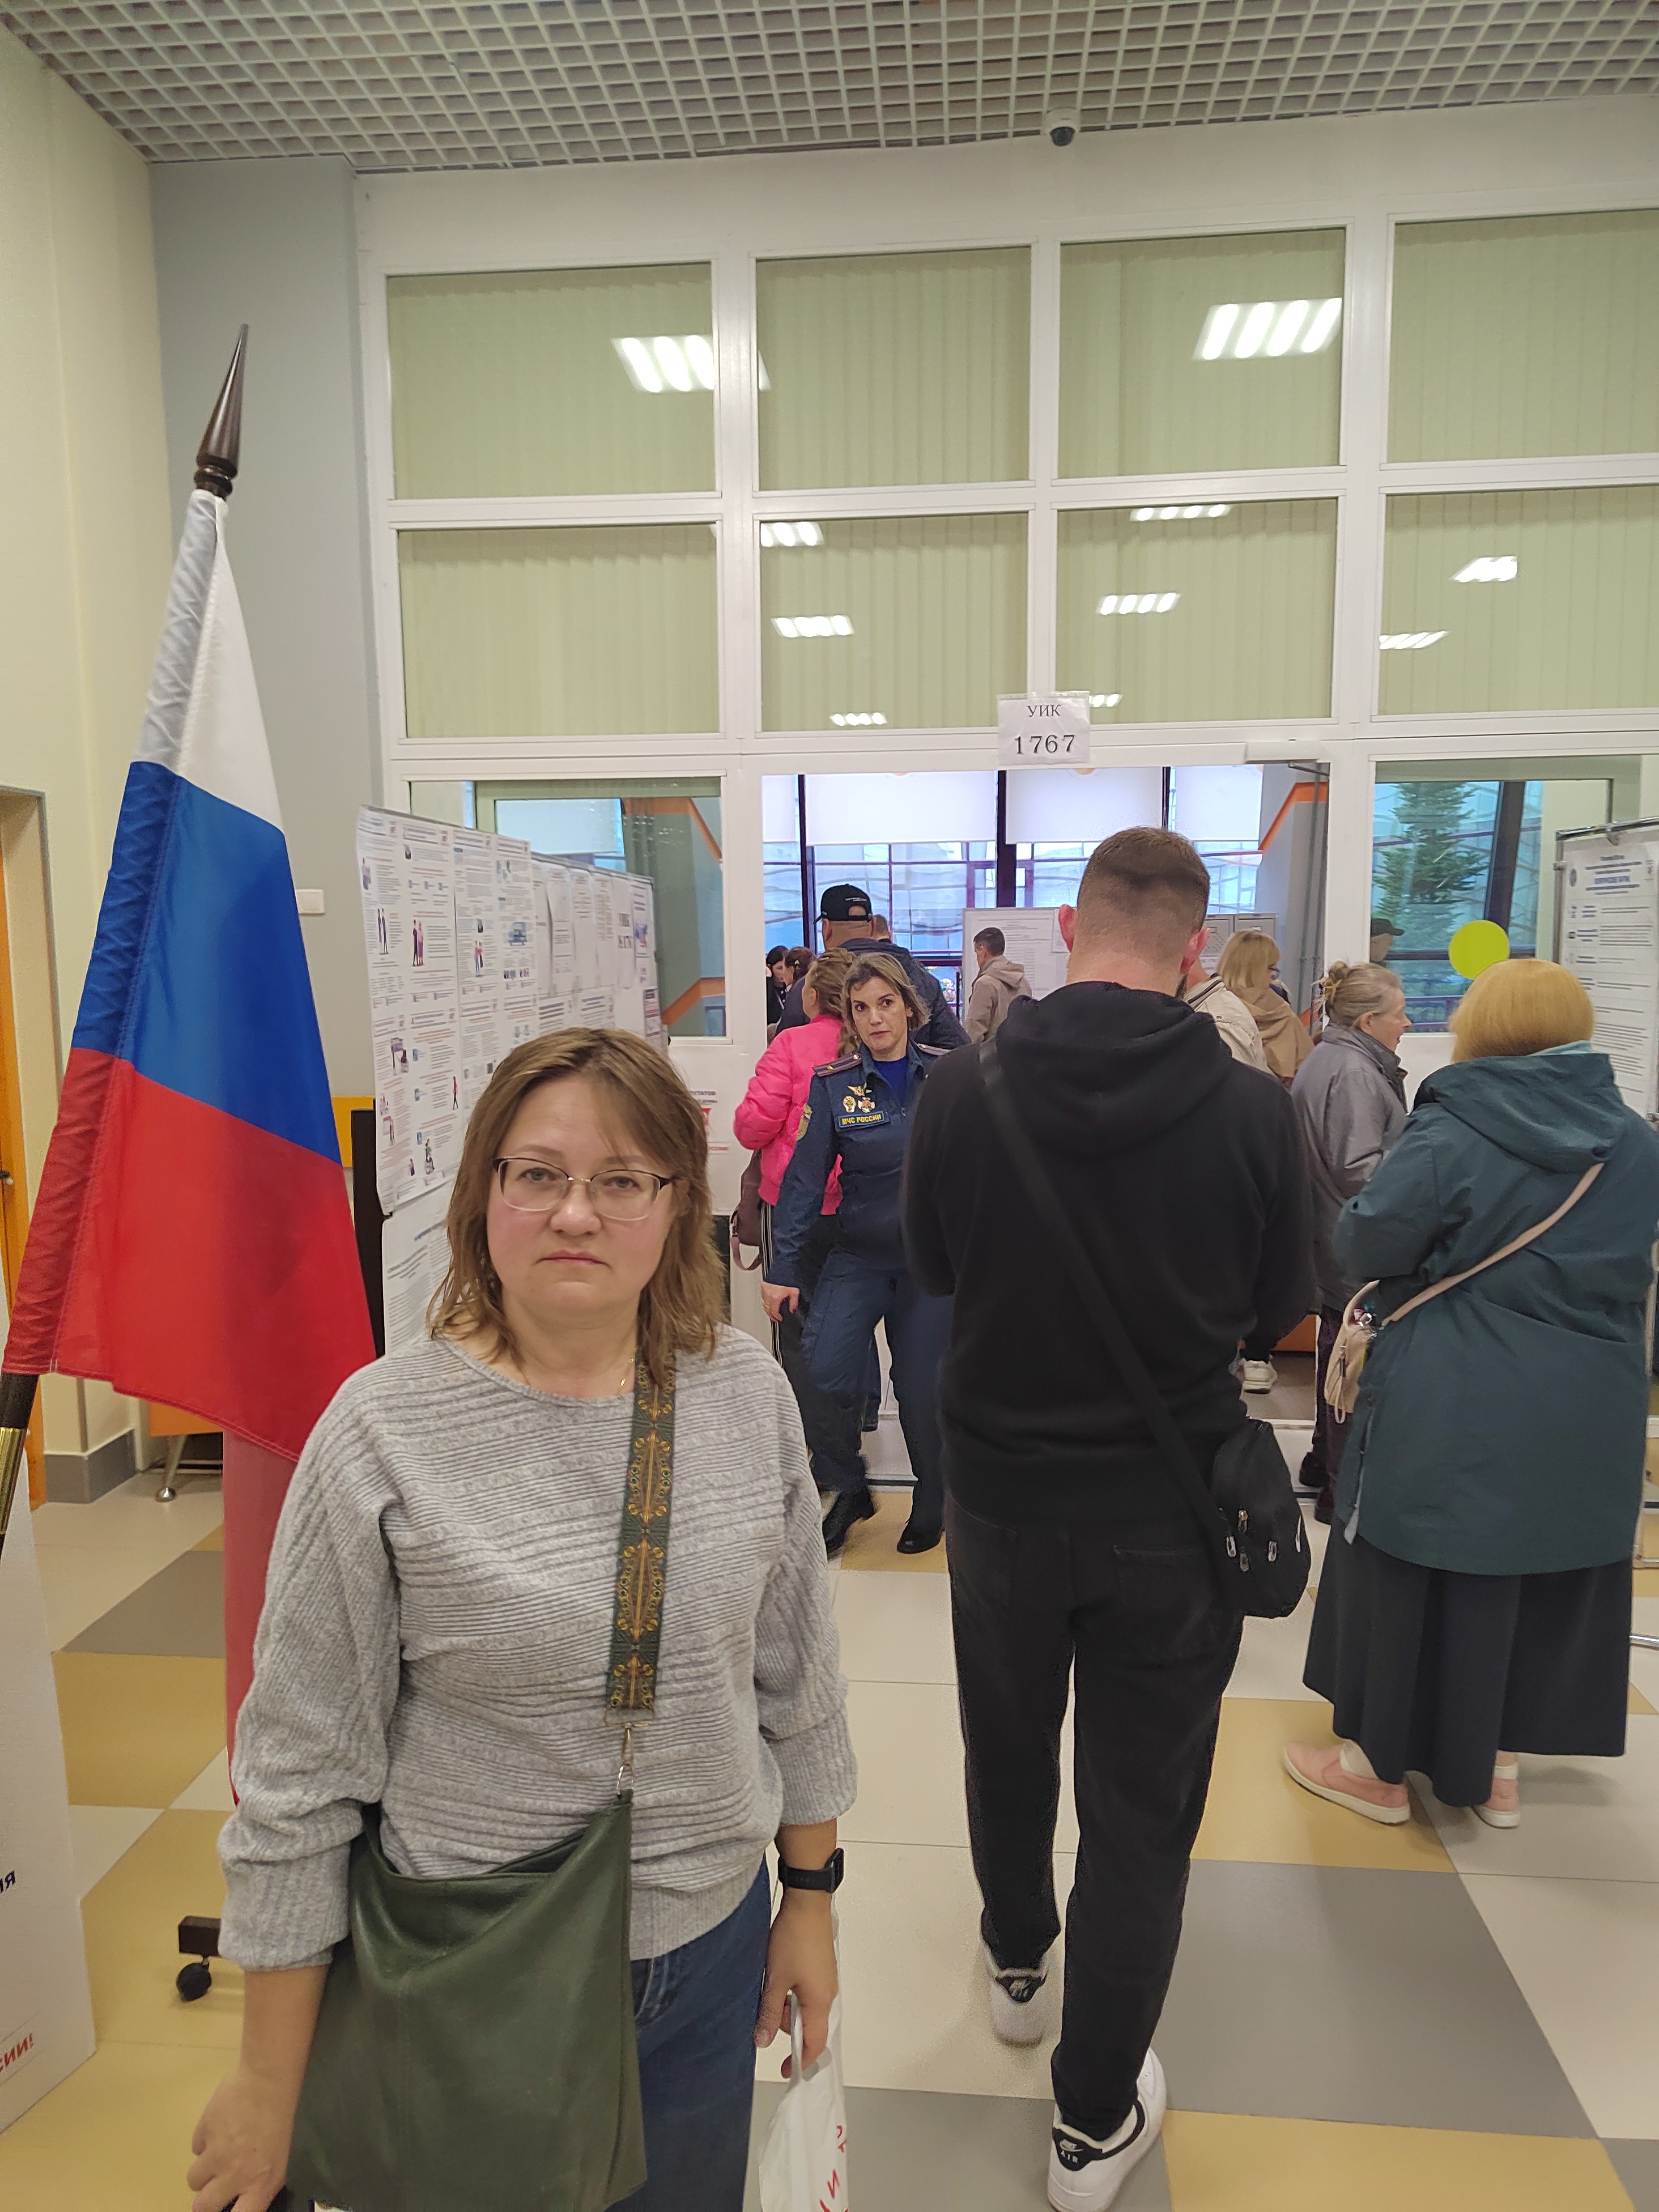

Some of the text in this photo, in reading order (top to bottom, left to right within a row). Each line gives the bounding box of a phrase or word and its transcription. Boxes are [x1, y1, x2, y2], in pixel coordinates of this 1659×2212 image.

[1027, 704, 1061, 717] УИК
[1014, 734, 1075, 755] 1767
[856, 1114, 881, 1122] РОССИИ
[1061, 2150, 1078, 2163] AIR
